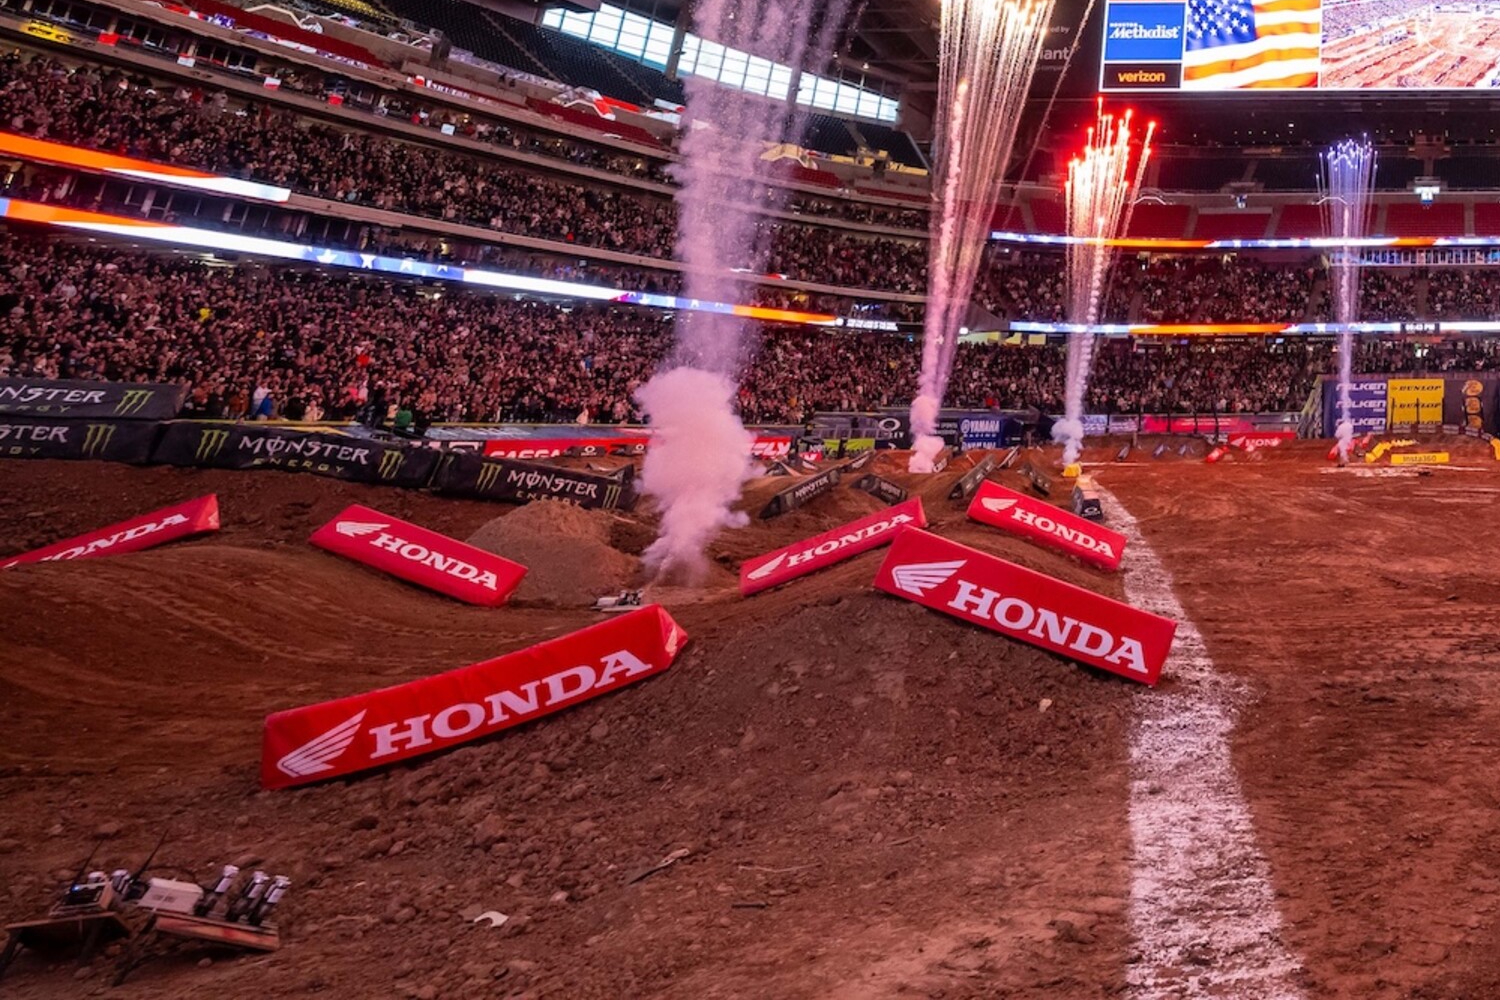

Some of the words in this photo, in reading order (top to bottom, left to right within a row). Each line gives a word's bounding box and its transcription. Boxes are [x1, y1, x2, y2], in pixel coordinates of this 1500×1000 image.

[1109, 24, 1180, 39] Methodist
[1118, 70, 1166, 82] verizon
[970, 419, 1000, 432] YAMAHA
[238, 436, 370, 465] MONSTER
[252, 457, 346, 473] ENERGY
[507, 469, 599, 499] MONSTER
[40, 513, 189, 561] ONDA
[786, 513, 915, 568] HONDA
[1011, 507, 1116, 559] HONDA
[369, 533, 498, 591] HONDA
[947, 579, 1149, 674] HONDA
[369, 650, 652, 759] HONDA
